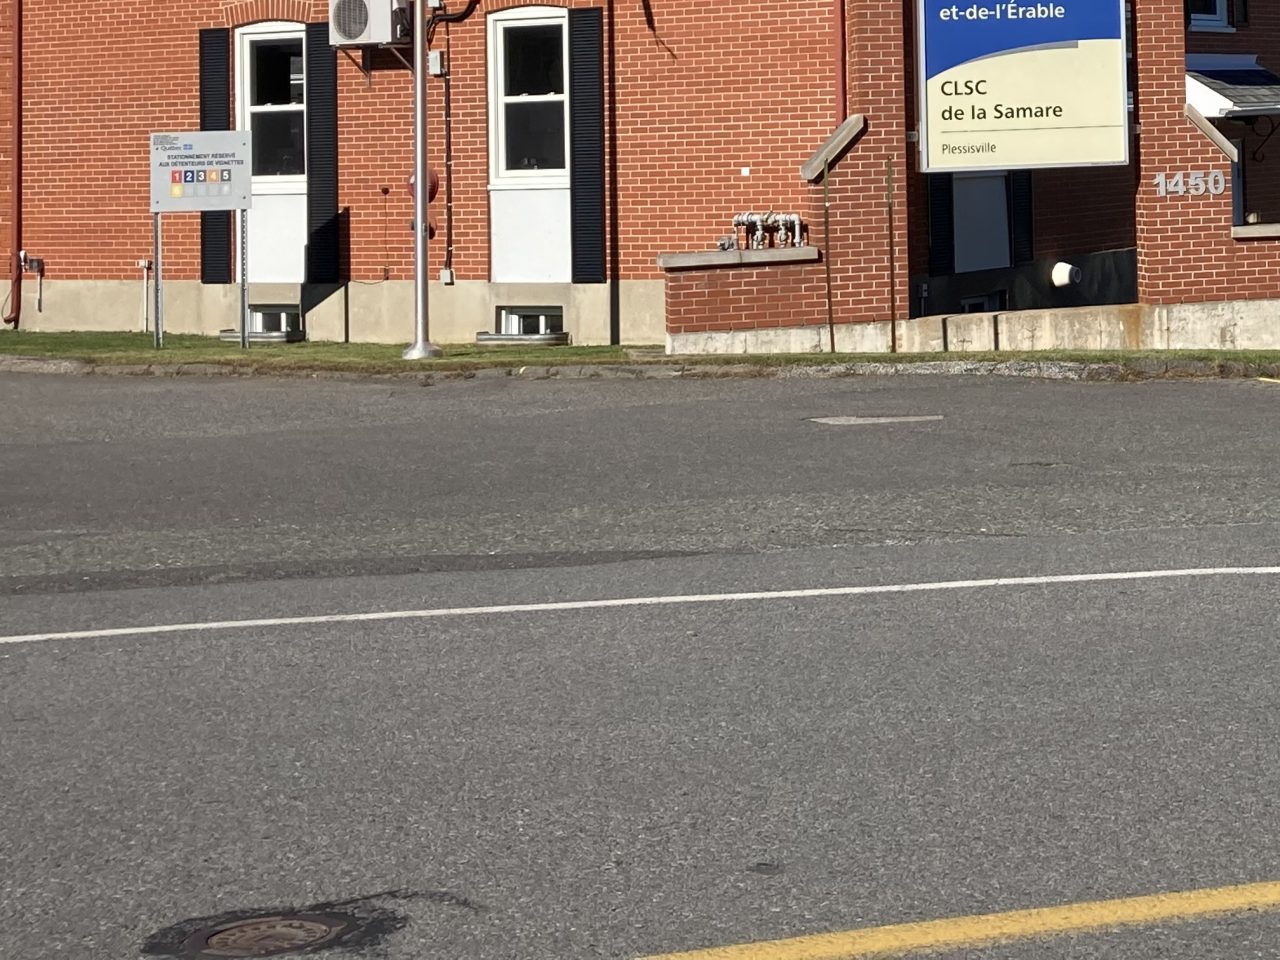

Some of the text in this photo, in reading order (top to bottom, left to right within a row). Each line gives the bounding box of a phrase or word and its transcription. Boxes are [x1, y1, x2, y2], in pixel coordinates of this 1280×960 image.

[940, 80, 988, 96] CLSC
[941, 104, 1063, 121] de la Samare
[941, 142, 997, 155] Plessisville
[185, 171, 193, 180] 2
[198, 171, 205, 180] 3
[209, 171, 217, 179] 4
[222, 170, 229, 179] 5
[1152, 170, 1225, 196] 1450
